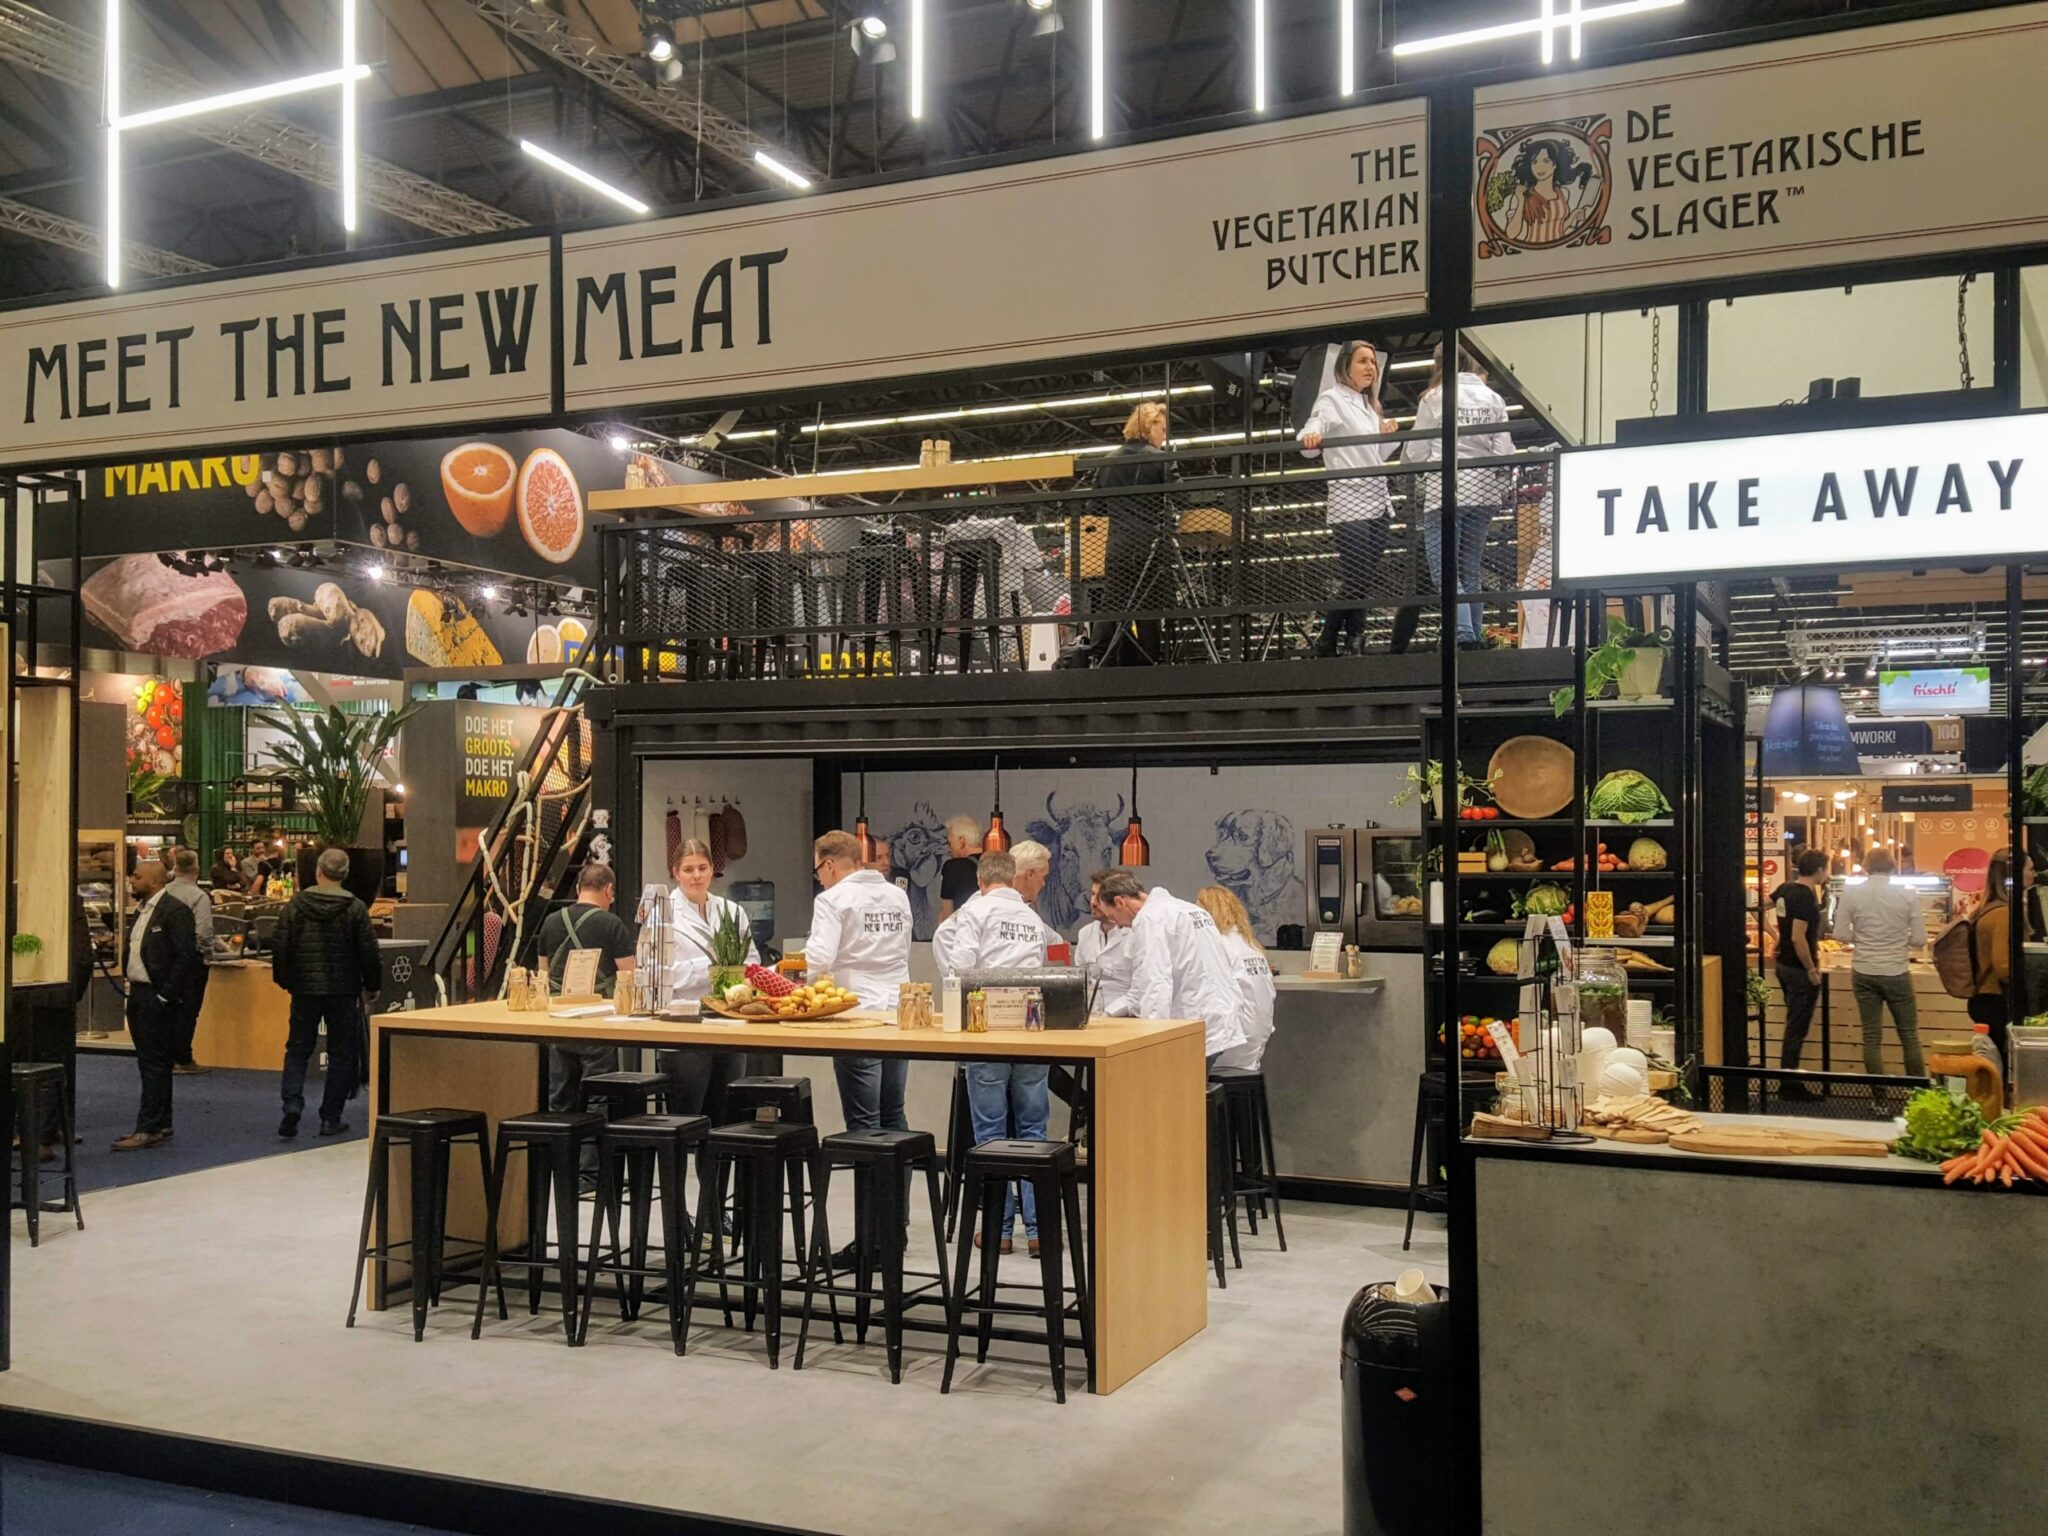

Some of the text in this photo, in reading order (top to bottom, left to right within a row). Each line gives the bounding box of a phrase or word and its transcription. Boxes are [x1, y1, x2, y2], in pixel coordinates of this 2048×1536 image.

[1627, 104, 1674, 143] DE
[1351, 143, 1419, 185] THE
[1628, 120, 1925, 191] VEGETARISCHE
[1213, 191, 1419, 250] VEGETARIAN
[1267, 239, 1421, 291] BUTCHER
[24, 247, 789, 424] MEET THE NEW MEAT
[1597, 458, 2024, 536] TAKE AWAY
[465, 715, 514, 737] DOE HET
[465, 736, 514, 757] GROOTS.
[465, 757, 514, 778] DOE HET
[465, 778, 508, 798] MAKRO
[864, 911, 902, 922] MEET THE
[864, 922, 903, 932] NEW MEAT
[1001, 921, 1019, 933] MEET
[1000, 930, 1038, 943] NEW MEAT
